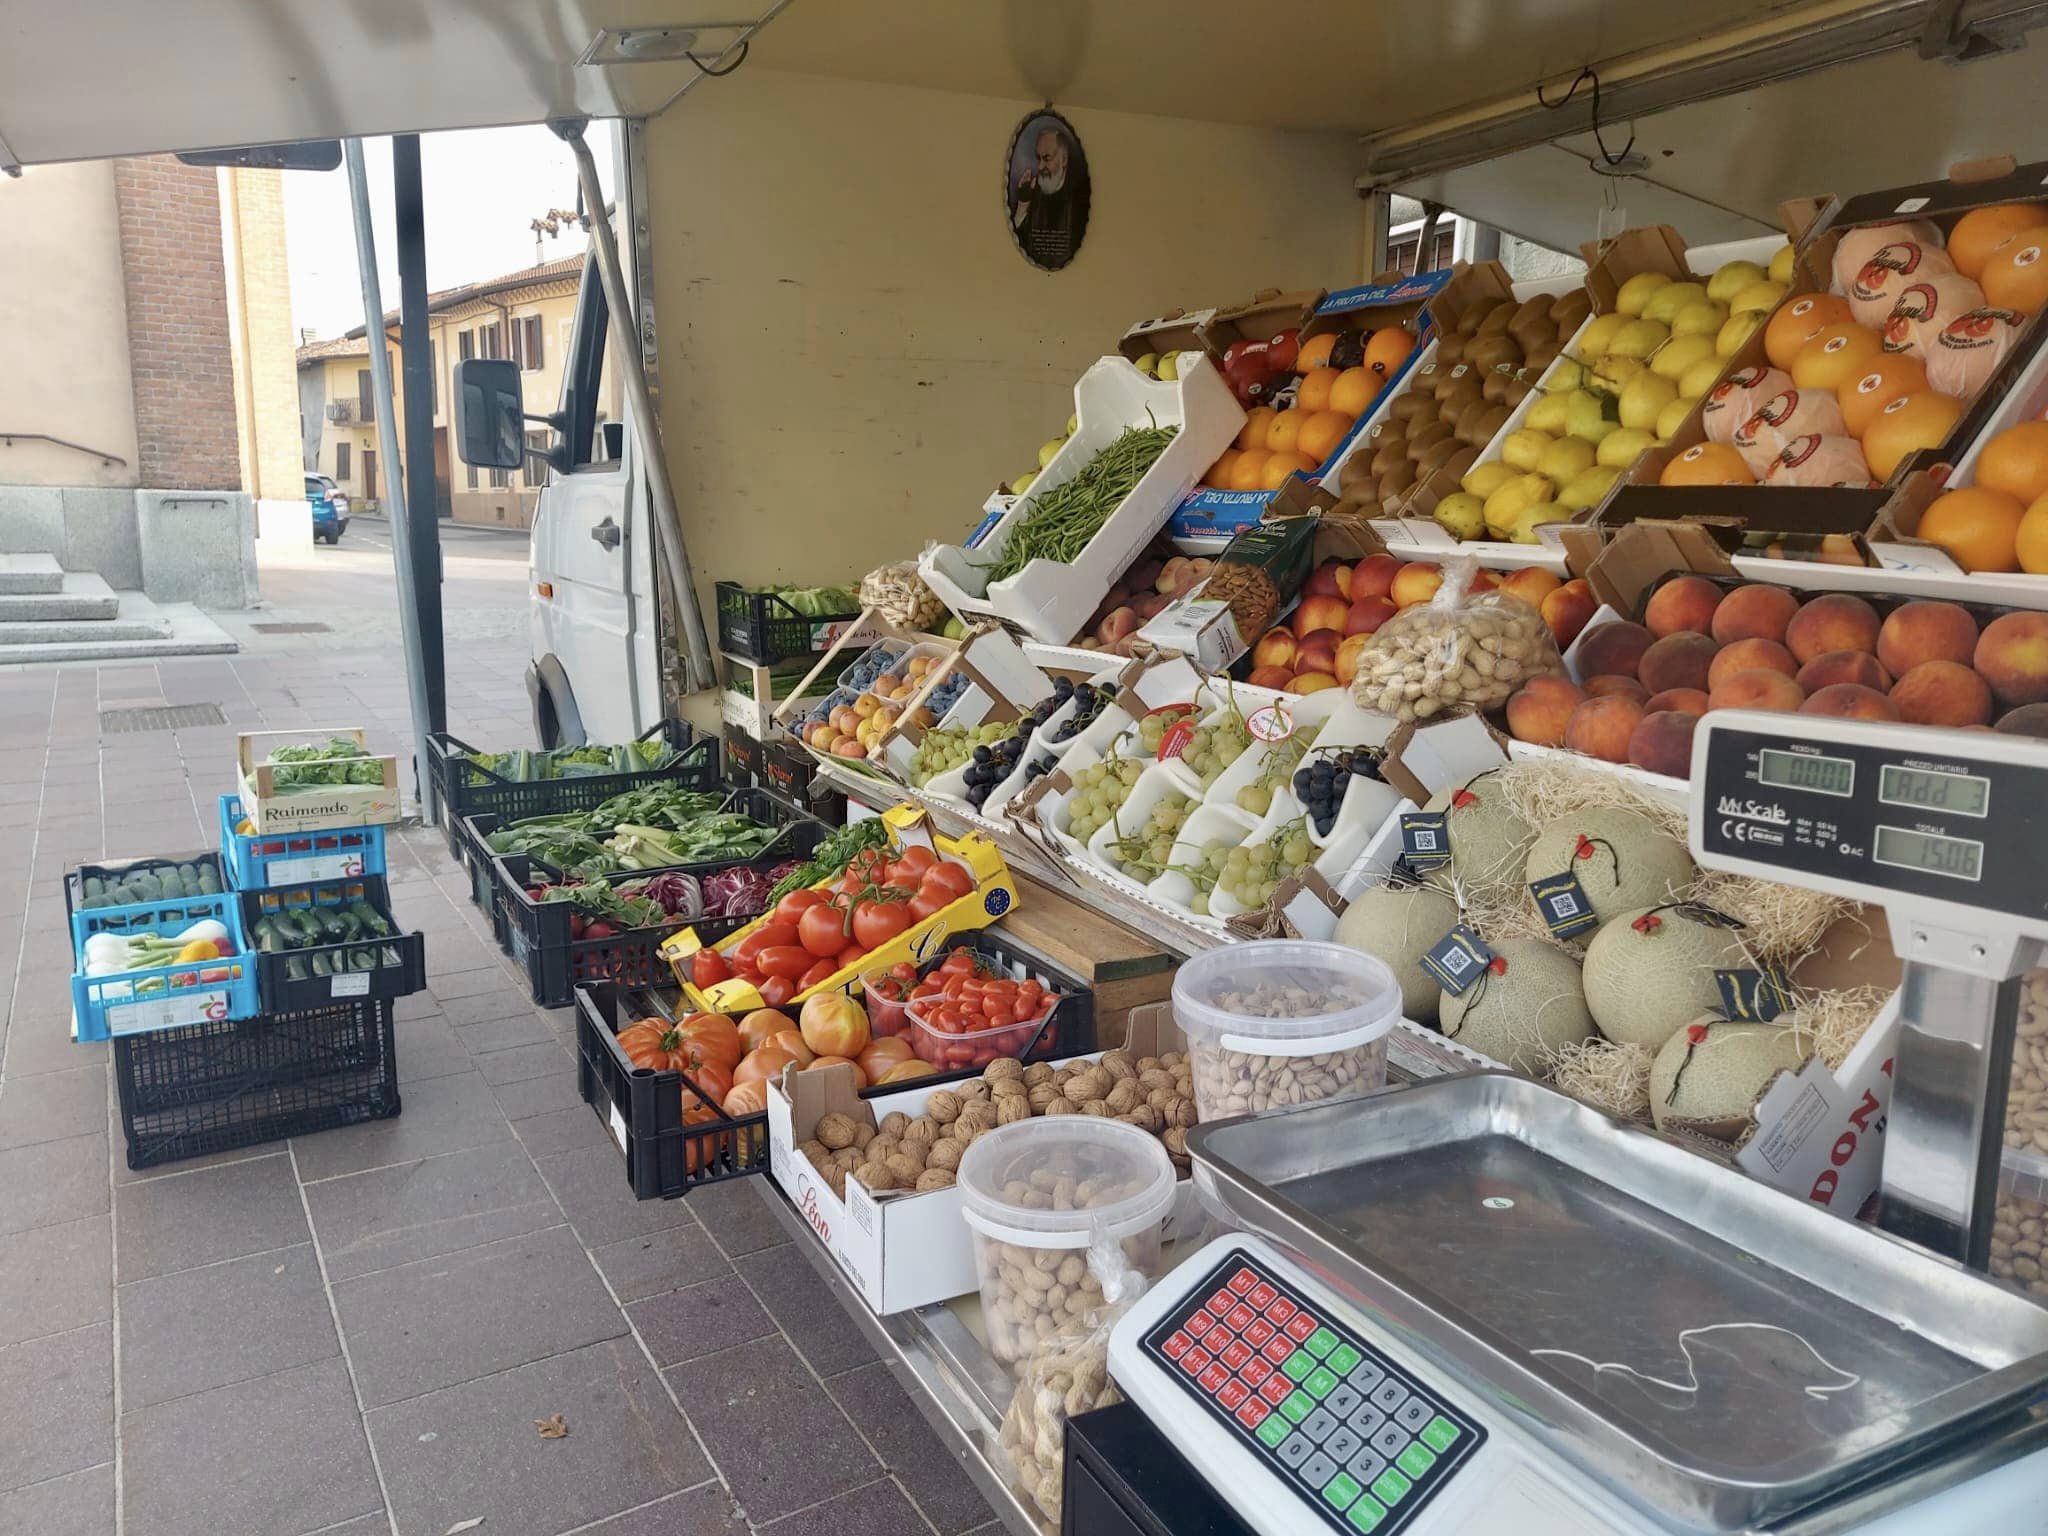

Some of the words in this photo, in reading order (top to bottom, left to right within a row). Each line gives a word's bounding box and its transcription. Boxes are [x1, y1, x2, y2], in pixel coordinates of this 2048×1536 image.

[1334, 293, 1367, 307] FRUTTA
[1367, 289, 1386, 300] DEL
[265, 801, 349, 822] Raimondo
[1746, 800, 1787, 822] Scale
[1236, 1276, 1249, 1289] M1
[1214, 1295, 1228, 1309] M5
[1254, 1290, 1268, 1304] M2
[1232, 1310, 1246, 1324] M6
[1273, 1303, 1289, 1318] M3
[1193, 1317, 1207, 1330] M9
[1293, 1318, 1308, 1334] M4
[1251, 1325, 1267, 1339] M7
[1170, 1337, 1187, 1352] M14
[1210, 1331, 1227, 1348] M10
[1229, 1346, 1245, 1362] M11
[1270, 1341, 1286, 1356] M8
[1188, 1352, 1205, 1369] M15
[1205, 1369, 1222, 1385] M16
[1247, 1362, 1266, 1380] M12
[1359, 1371, 1373, 1381] 7
[1223, 1386, 1242, 1403] M17
[1268, 1380, 1286, 1398] M13
[1384, 1390, 1396, 1401] 8
[1337, 1395, 1350, 1406] 4
[1244, 1401, 1264, 1421] M18
[1408, 1408, 1420, 1420] 9
[1315, 1420, 1326, 1431] 1
[1360, 1414, 1373, 1425] 5
[1336, 1440, 1349, 1451] 2
[1384, 1434, 1397, 1446] 6
[1289, 1444, 1302, 1455] 0
[1360, 1459, 1373, 1471] 3
